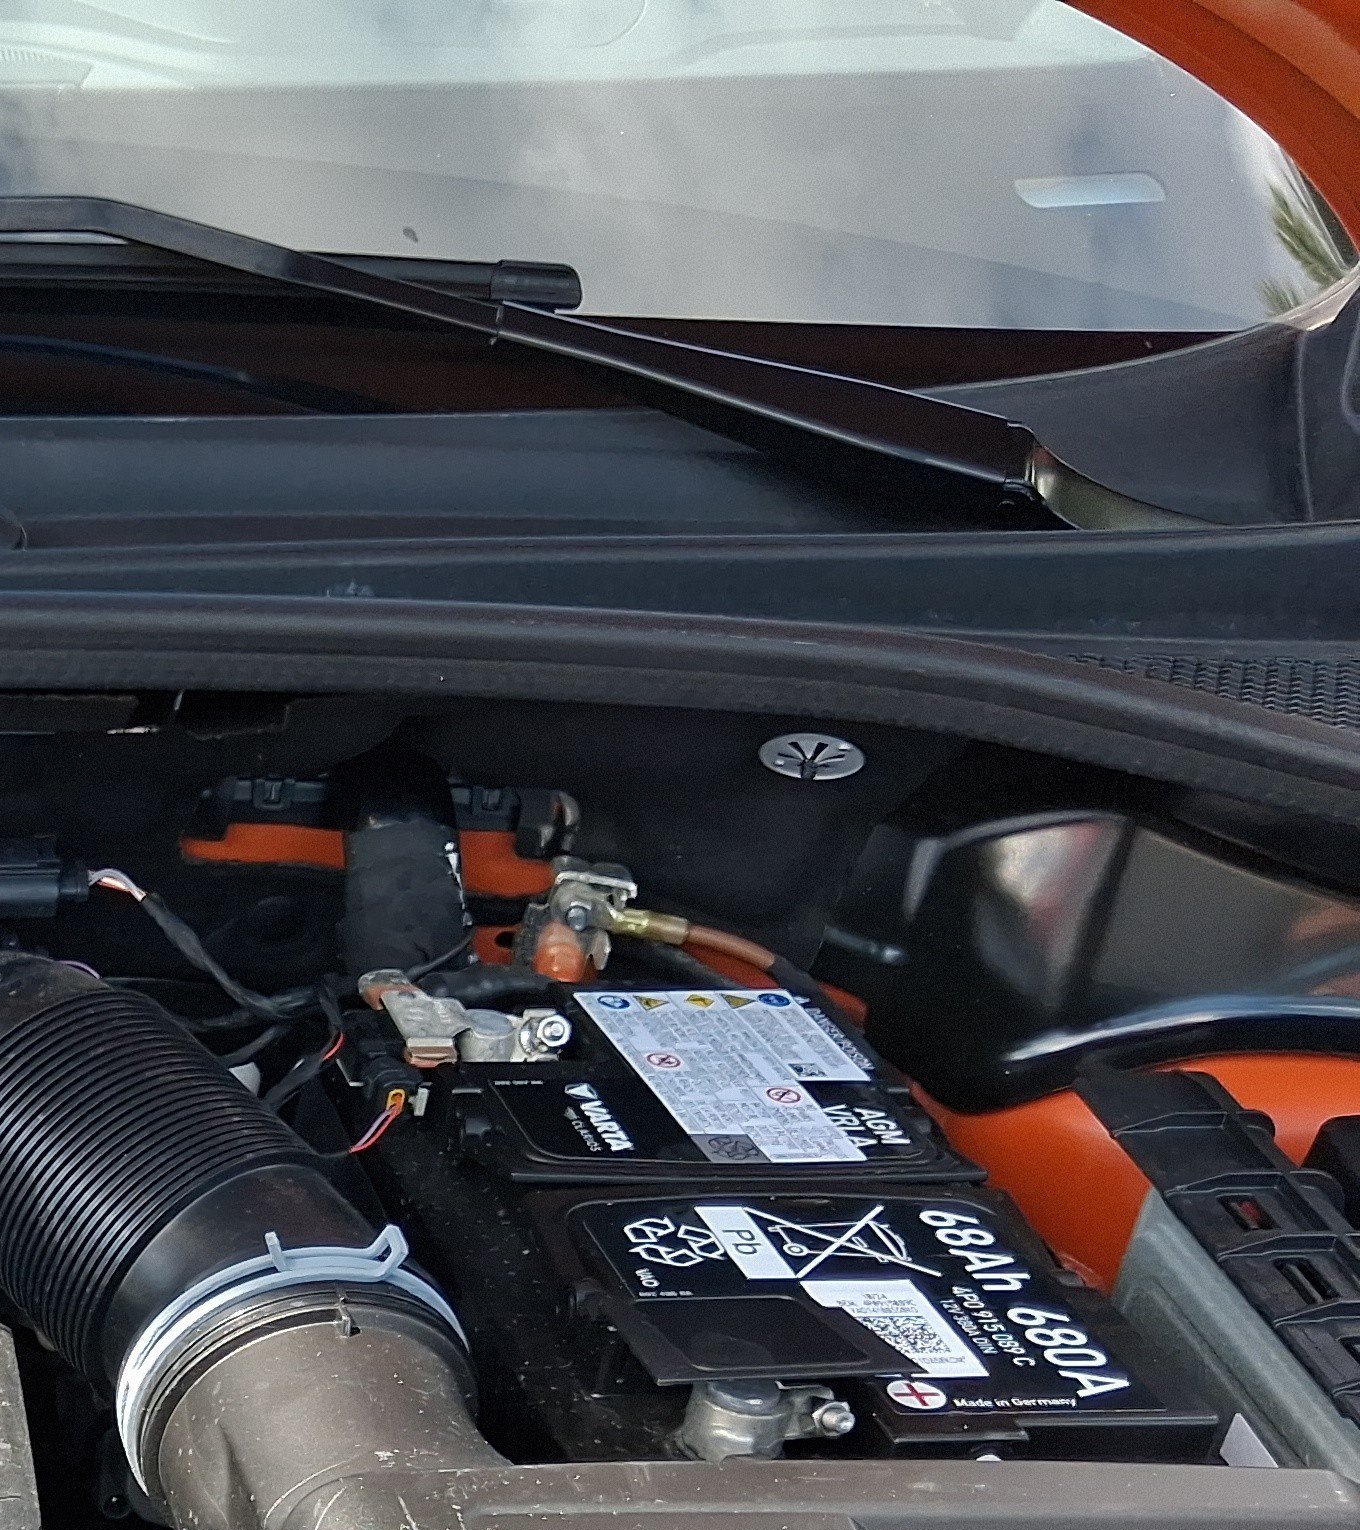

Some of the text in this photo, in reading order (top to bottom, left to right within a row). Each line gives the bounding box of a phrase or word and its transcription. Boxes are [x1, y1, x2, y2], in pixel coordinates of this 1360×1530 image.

[579, 1099, 634, 1152] VARTA
[853, 1107, 911, 1145] AGM
[722, 1229, 762, 1256] Pb
[919, 1209, 1031, 1292] 68Ah
[1006, 1306, 1130, 1398] 680A
[971, 1311, 1006, 1332] 915
[1012, 1357, 1036, 1366] C
[972, 1337, 999, 1354] DIN
[953, 1397, 1077, 1409] Made in Germany
